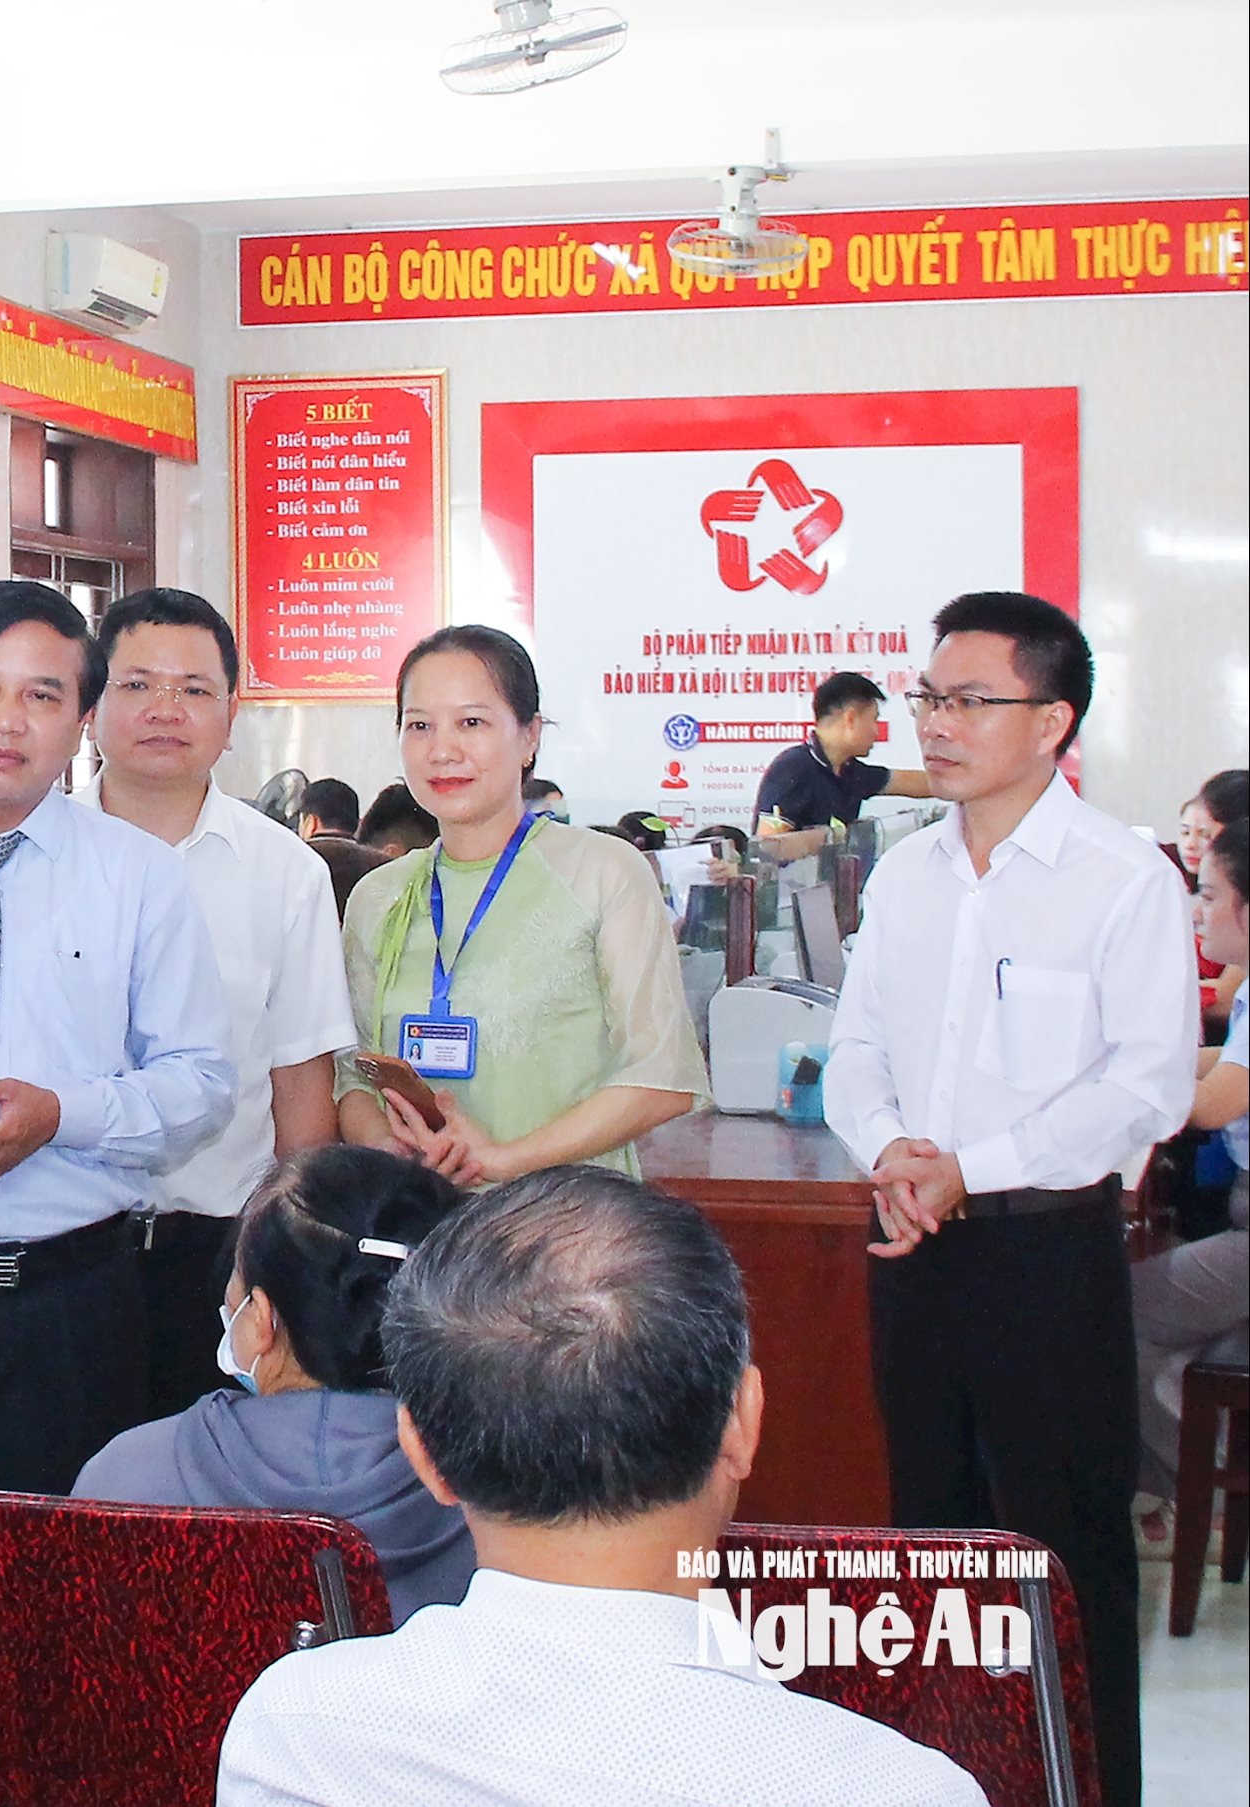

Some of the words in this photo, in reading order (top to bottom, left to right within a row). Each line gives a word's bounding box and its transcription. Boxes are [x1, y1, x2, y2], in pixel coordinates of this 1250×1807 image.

[260, 243, 331, 308] CÁN
[343, 241, 389, 313] BỘ
[399, 239, 493, 301] CÔNG
[502, 232, 597, 299] CHỨC
[608, 231, 659, 297] XÃ
[847, 214, 963, 293] QUYẾT
[976, 217, 1055, 283] TÂM
[1072, 218, 1170, 289] THỰC
[1185, 207, 1249, 286] HIỆ
[306, 405, 316, 421] 5
[322, 395, 372, 420] BIẾT
[277, 431, 307, 447] Biết
[311, 432, 348, 449] nghe
[352, 431, 382, 445] dân
[386, 430, 410, 444] nói
[277, 453, 307, 470] Biết
[312, 455, 336, 469] nói
[339, 454, 368, 468] dân
[373, 450, 406, 467] hiểu
[277, 476, 308, 492] Biết
[312, 478, 340, 492] làm
[344, 477, 374, 491] dân
[378, 476, 399, 490] tin
[277, 498, 308, 515] Biết
[312, 500, 336, 514] xin
[340, 497, 360, 513] lỗi
[278, 521, 308, 538] Biết
[348, 524, 368, 536] ơn
[302, 552, 313, 569] 4
[318, 547, 379, 569] LUÔN
[278, 578, 318, 592] Luôn
[362, 577, 395, 591] cười
[278, 601, 318, 615] Luôn
[324, 601, 351, 617] nhẹ
[356, 600, 404, 616] nhàng
[278, 624, 319, 638] Luôn
[323, 621, 356, 639] lắng
[361, 623, 398, 639] nghe
[643, 628, 661, 660] BỘ
[666, 628, 706, 660] PHẬN
[710, 623, 742, 655] TIẾP
[747, 627, 787, 660] NHẬN
[878, 624, 907, 655] QUẢ
[278, 646, 319, 660] Luôn
[323, 646, 357, 662] giúp
[361, 646, 381, 659] đỡ
[604, 664, 632, 693] BẢO
[637, 660, 673, 693] HIỂM
[678, 666, 698, 693] XÃ
[702, 667, 726, 698] NỘI
[732, 666, 762, 693] LÊN
[705, 722, 750, 740] HÀNH
[754, 723, 804, 740] CHÍNH
